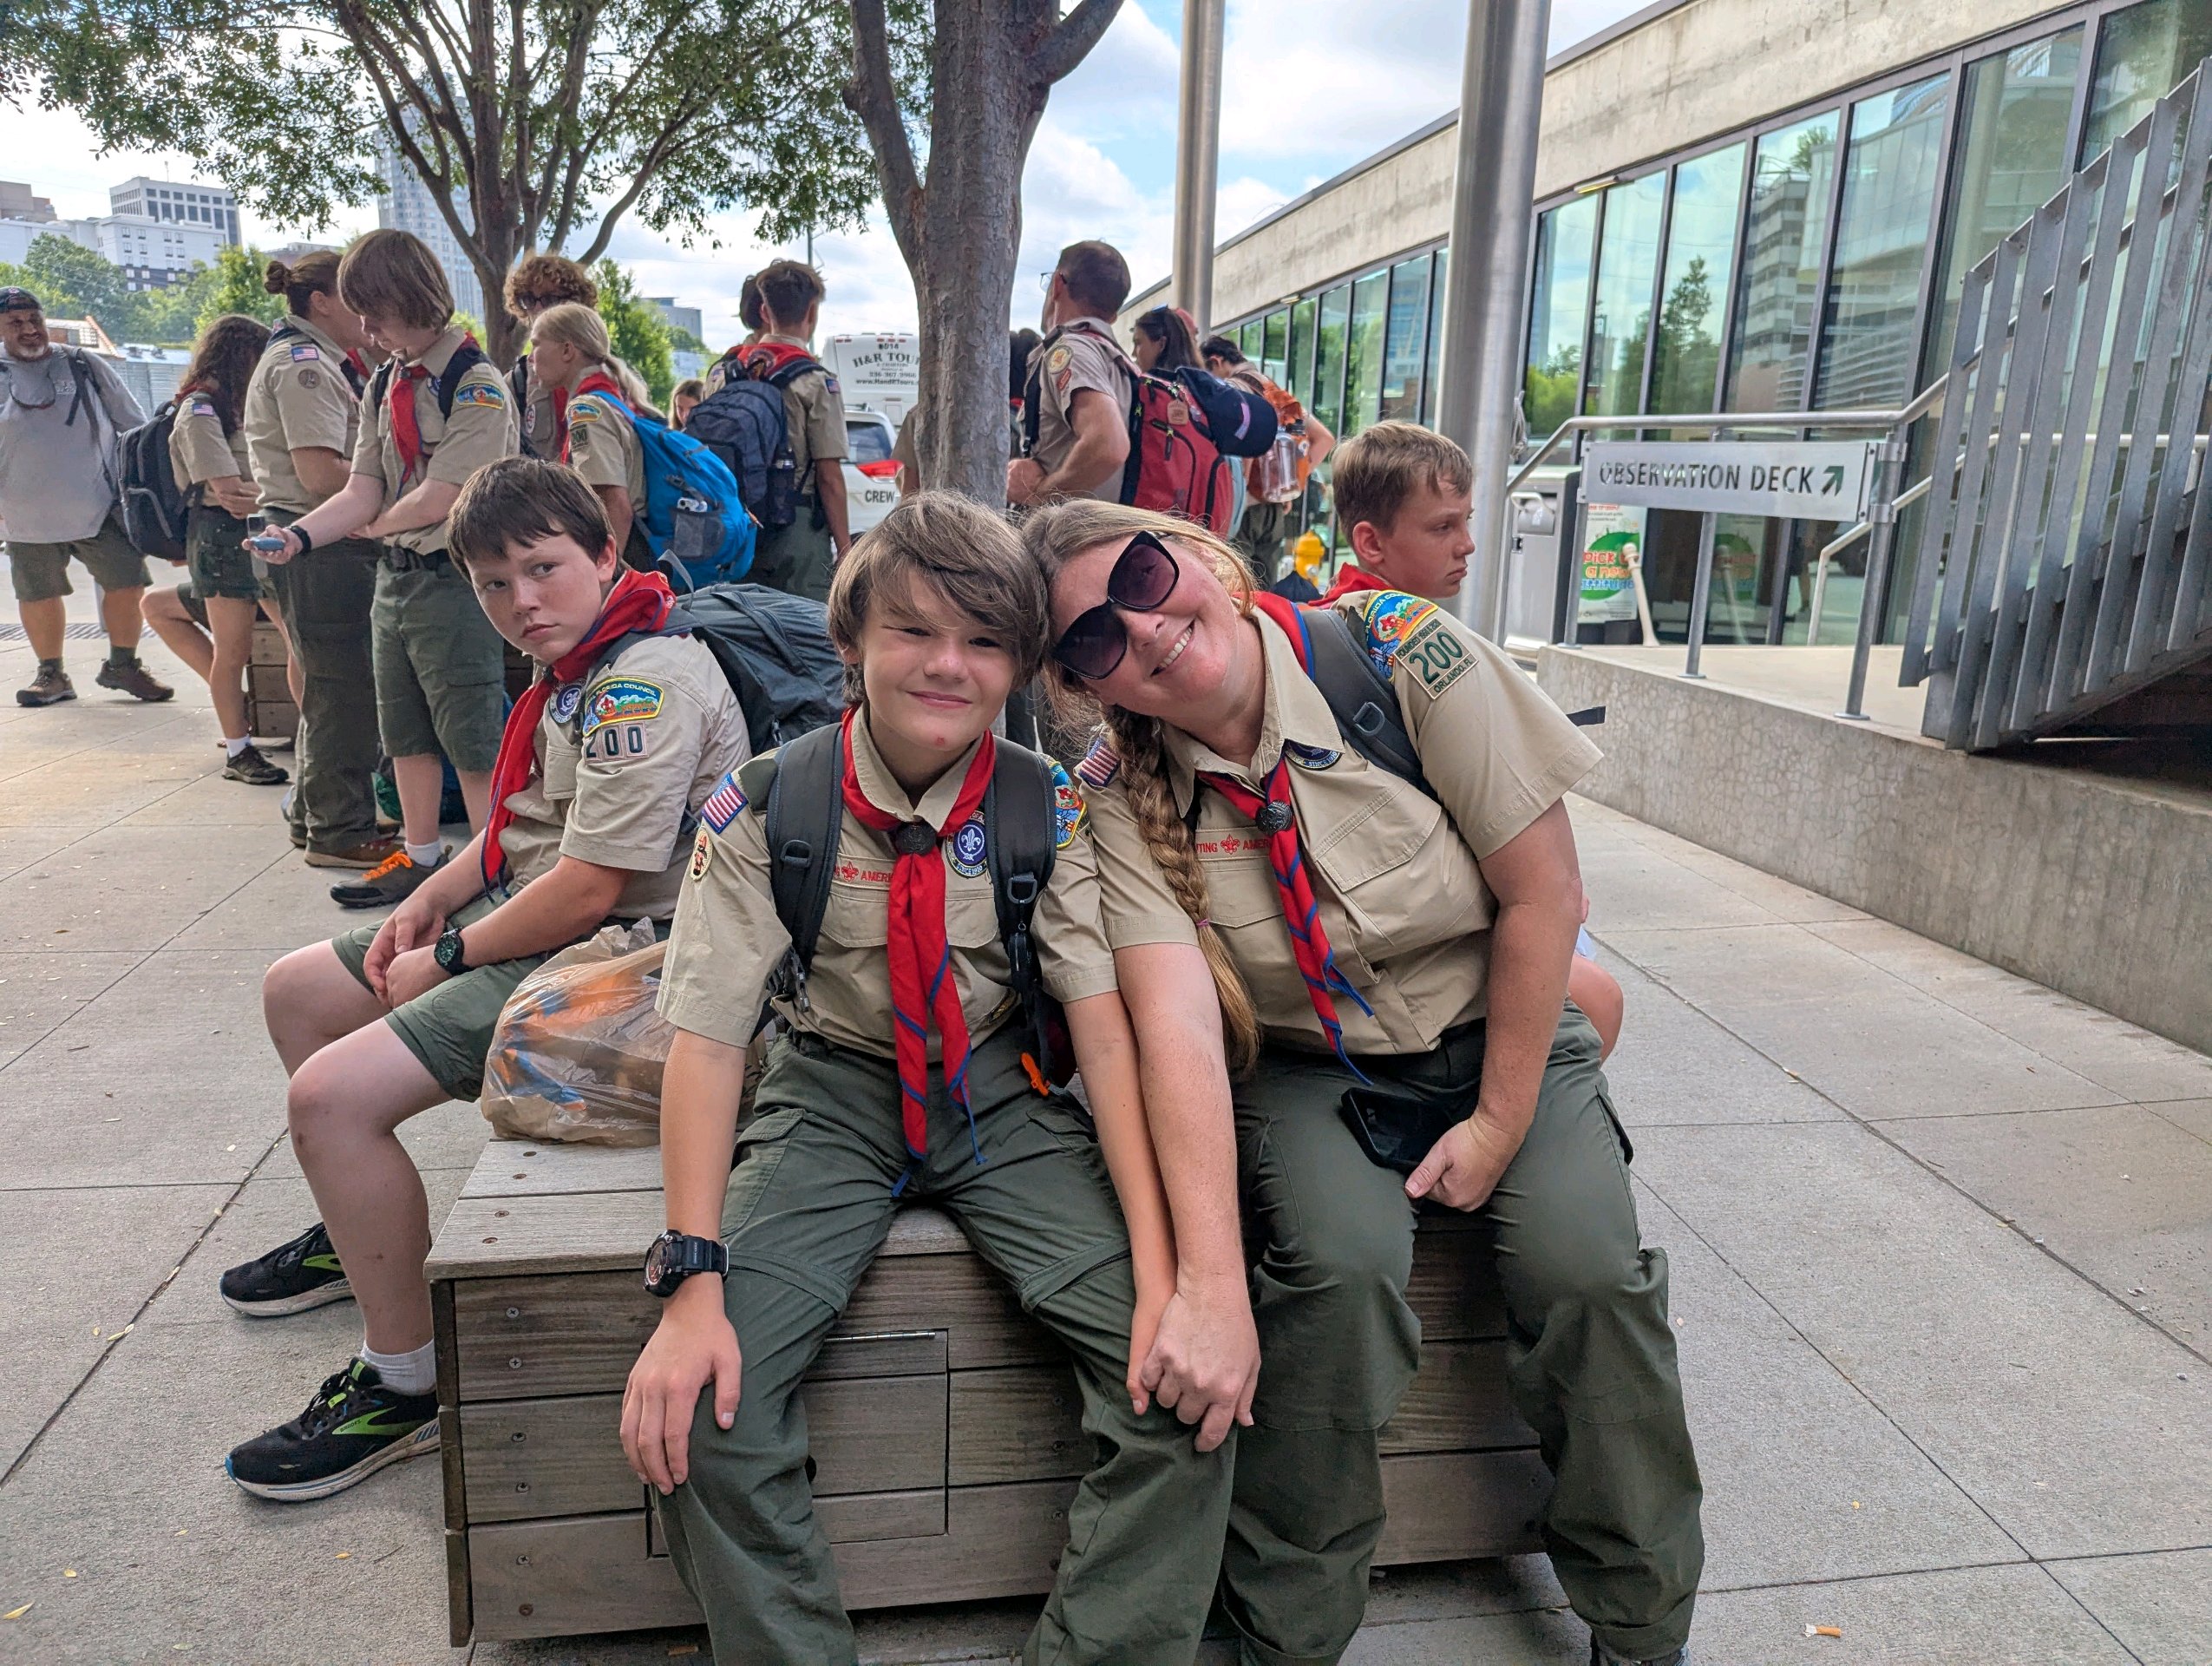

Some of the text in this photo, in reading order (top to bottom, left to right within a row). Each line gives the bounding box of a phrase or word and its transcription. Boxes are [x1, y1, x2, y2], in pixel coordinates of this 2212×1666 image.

[853, 353, 882, 367] H&R
[1599, 462, 1815, 493] OBSERVATION DECK
[865, 489, 894, 503] CREW
[1397, 636, 1421, 659] FOUNDED
[1409, 632, 1463, 685] 200
[1463, 658, 1472, 666] FL
[624, 683, 657, 697] COUNCIL
[586, 725, 644, 758] 200
[1195, 839, 1269, 853] TING AMER
[861, 870, 893, 882] AMERI
